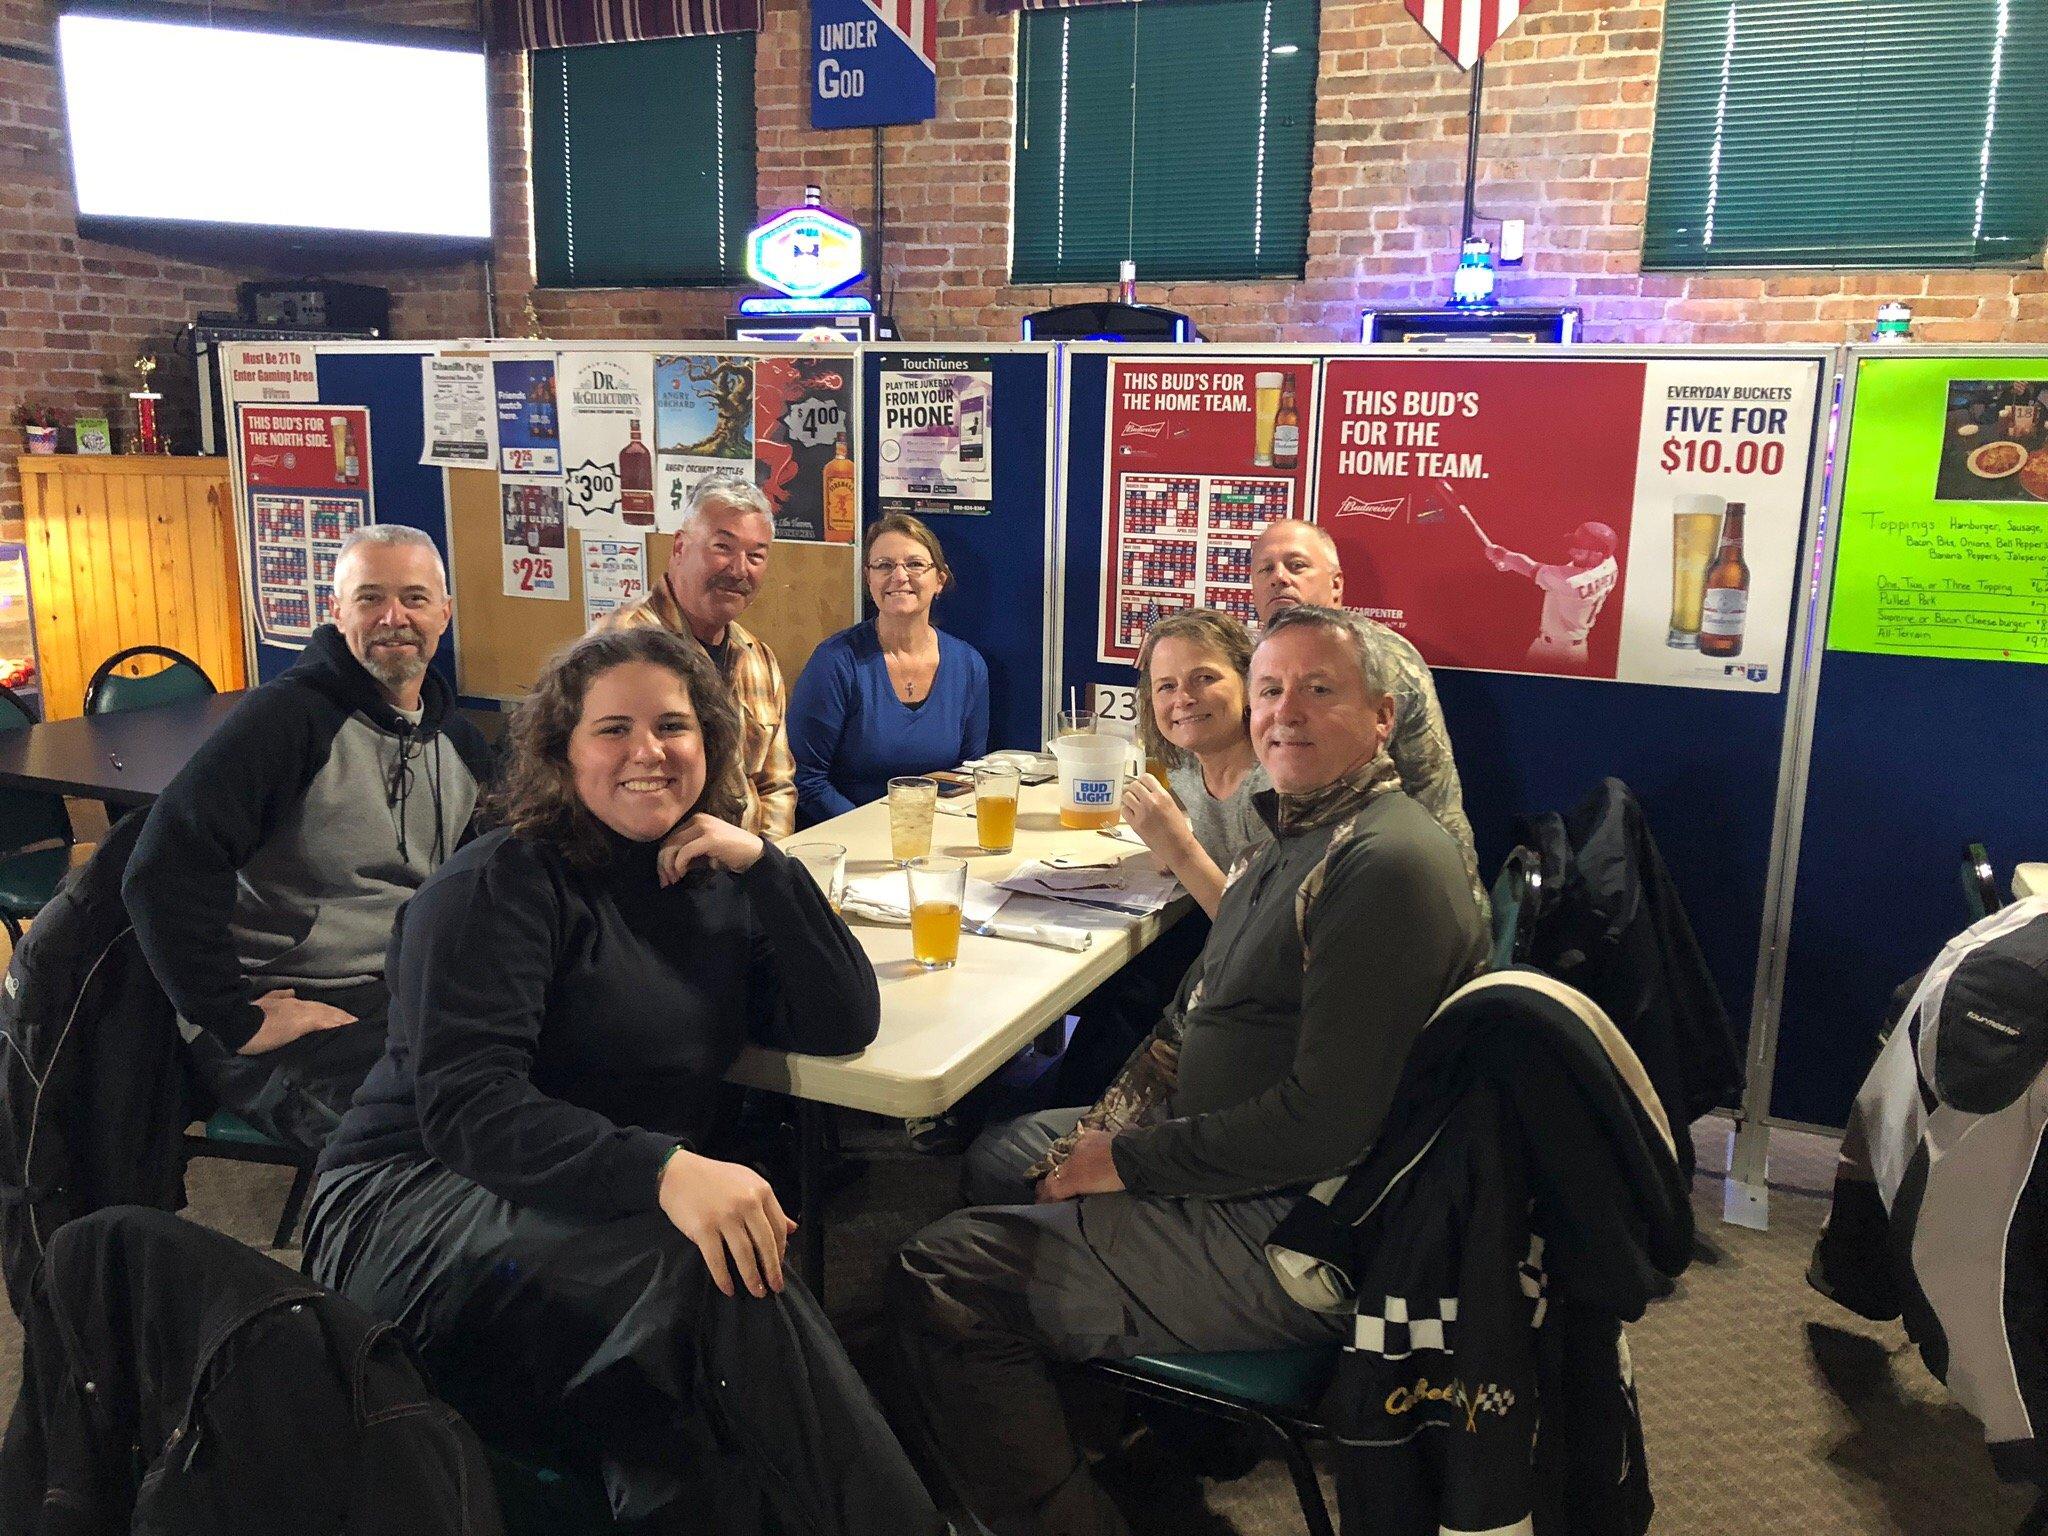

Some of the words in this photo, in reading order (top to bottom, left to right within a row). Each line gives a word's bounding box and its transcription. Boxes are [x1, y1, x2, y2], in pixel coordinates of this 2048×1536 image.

[820, 20, 878, 51] UNDER
[243, 352, 264, 364] Must
[265, 352, 277, 364] Be
[279, 352, 289, 364] 21
[290, 352, 301, 365] To
[901, 358, 969, 370] TouchTunes
[234, 369, 256, 381] Enter
[257, 369, 291, 383] Gaming
[293, 369, 314, 382] Area
[592, 370, 618, 390] DR.
[1123, 372, 1158, 390] THIS
[1161, 373, 1209, 391] BUD'S
[1212, 373, 1245, 391] FOR
[885, 382, 903, 391] PLAY
[904, 380, 918, 390] THE
[919, 378, 954, 389] JUKEBOX
[885, 391, 918, 407] FROM
[921, 389, 954, 403] YOUR
[1667, 385, 1731, 399] EVERYDAY
[1733, 386, 1792, 400] BUCKETS
[1122, 393, 1151, 410] THE
[1154, 394, 1200, 411] HOME
[1204, 394, 1251, 412] TEAM.
[1342, 390, 1397, 416] THIS
[1402, 391, 1480, 418] BUD'S
[247, 416, 271, 430] THIS
[304, 417, 325, 431] FOR
[886, 405, 954, 429] PHONE
[1665, 405, 1724, 433] FIVE
[1731, 407, 1788, 434] FOR
[249, 431, 269, 446] THE
[270, 432, 304, 447] NORTH
[305, 433, 332, 447] SIDE.
[1340, 420, 1387, 445] FOR
[1393, 421, 1440, 447] THE
[1661, 435, 1785, 475] $10.00
[665, 463, 685, 472] ANGRY
[1338, 450, 1410, 476] HOME
[1415, 452, 1490, 479] TEAM.
[1342, 499, 1397, 514] Budweiser
[506, 513, 527, 523] LIVE
[529, 515, 560, 525] ULTRA
[1861, 511, 1936, 537] Toppings
[1906, 535, 1934, 547] Bacon
[1996, 537, 2013, 549] Bell
[1929, 548, 1962, 560] Banana
[1927, 581, 1938, 589] or
[1942, 578, 1971, 591] Three
[1978, 579, 2013, 596] Topping
[1880, 591, 1911, 606] Pulled
[1918, 592, 1937, 606] Pork
[1351, 606, 1404, 620] CARPENTER
[1878, 610, 1916, 624] Supreme
[1918, 615, 1930, 624] or
[1935, 612, 1961, 624] Bacon
[1099, 690, 1138, 721] 23
[1080, 782, 1108, 793] BUD
[1075, 791, 1112, 803] LIGHT
